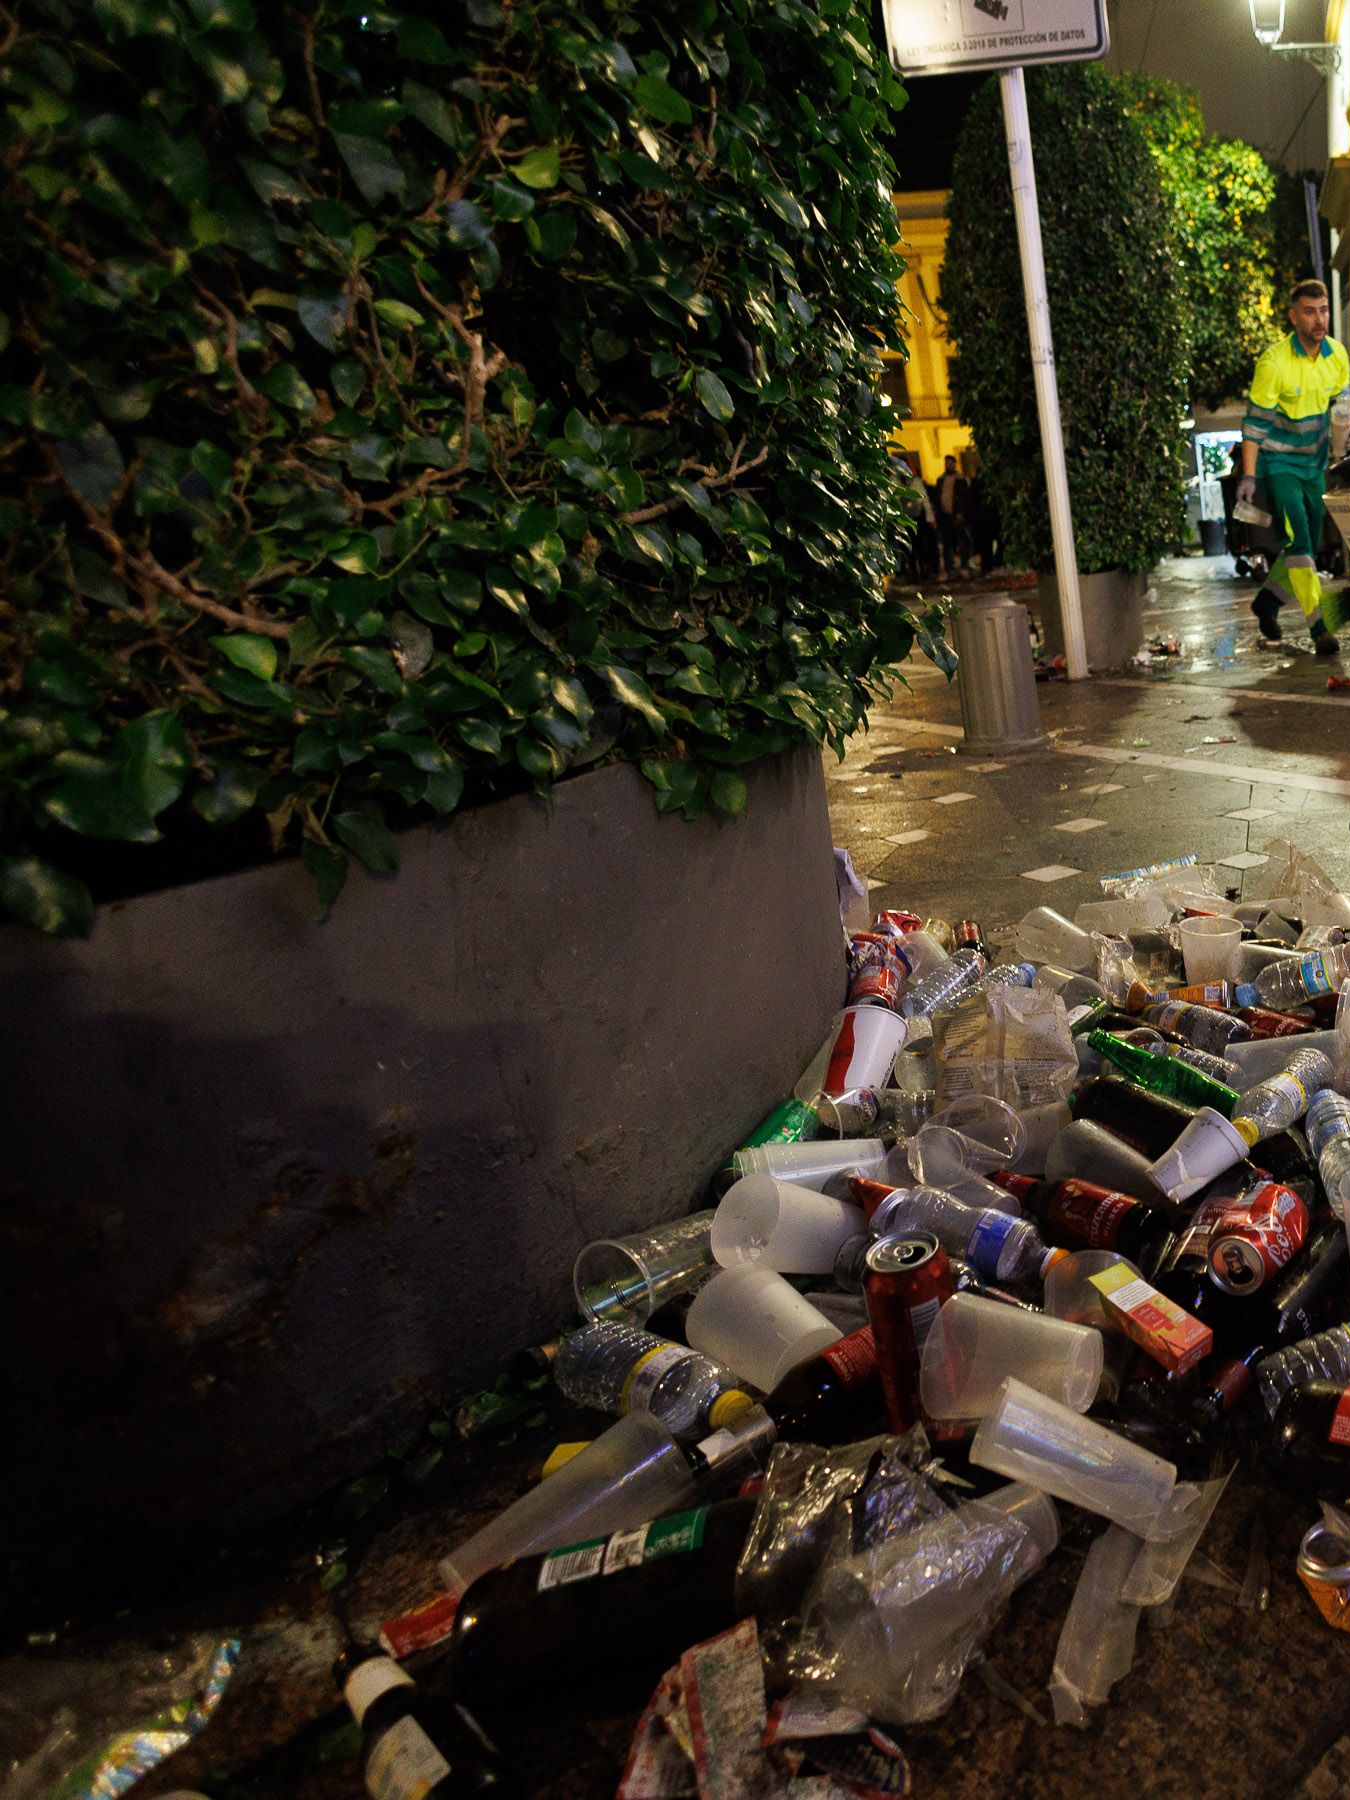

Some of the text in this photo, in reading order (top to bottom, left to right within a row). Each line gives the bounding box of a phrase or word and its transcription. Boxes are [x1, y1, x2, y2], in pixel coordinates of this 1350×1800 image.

[987, 37, 997, 49] DE
[1000, 32, 1047, 47] PROTECCIÓN
[1049, 31, 1058, 42] DE
[1061, 29, 1085, 41] DATOS
